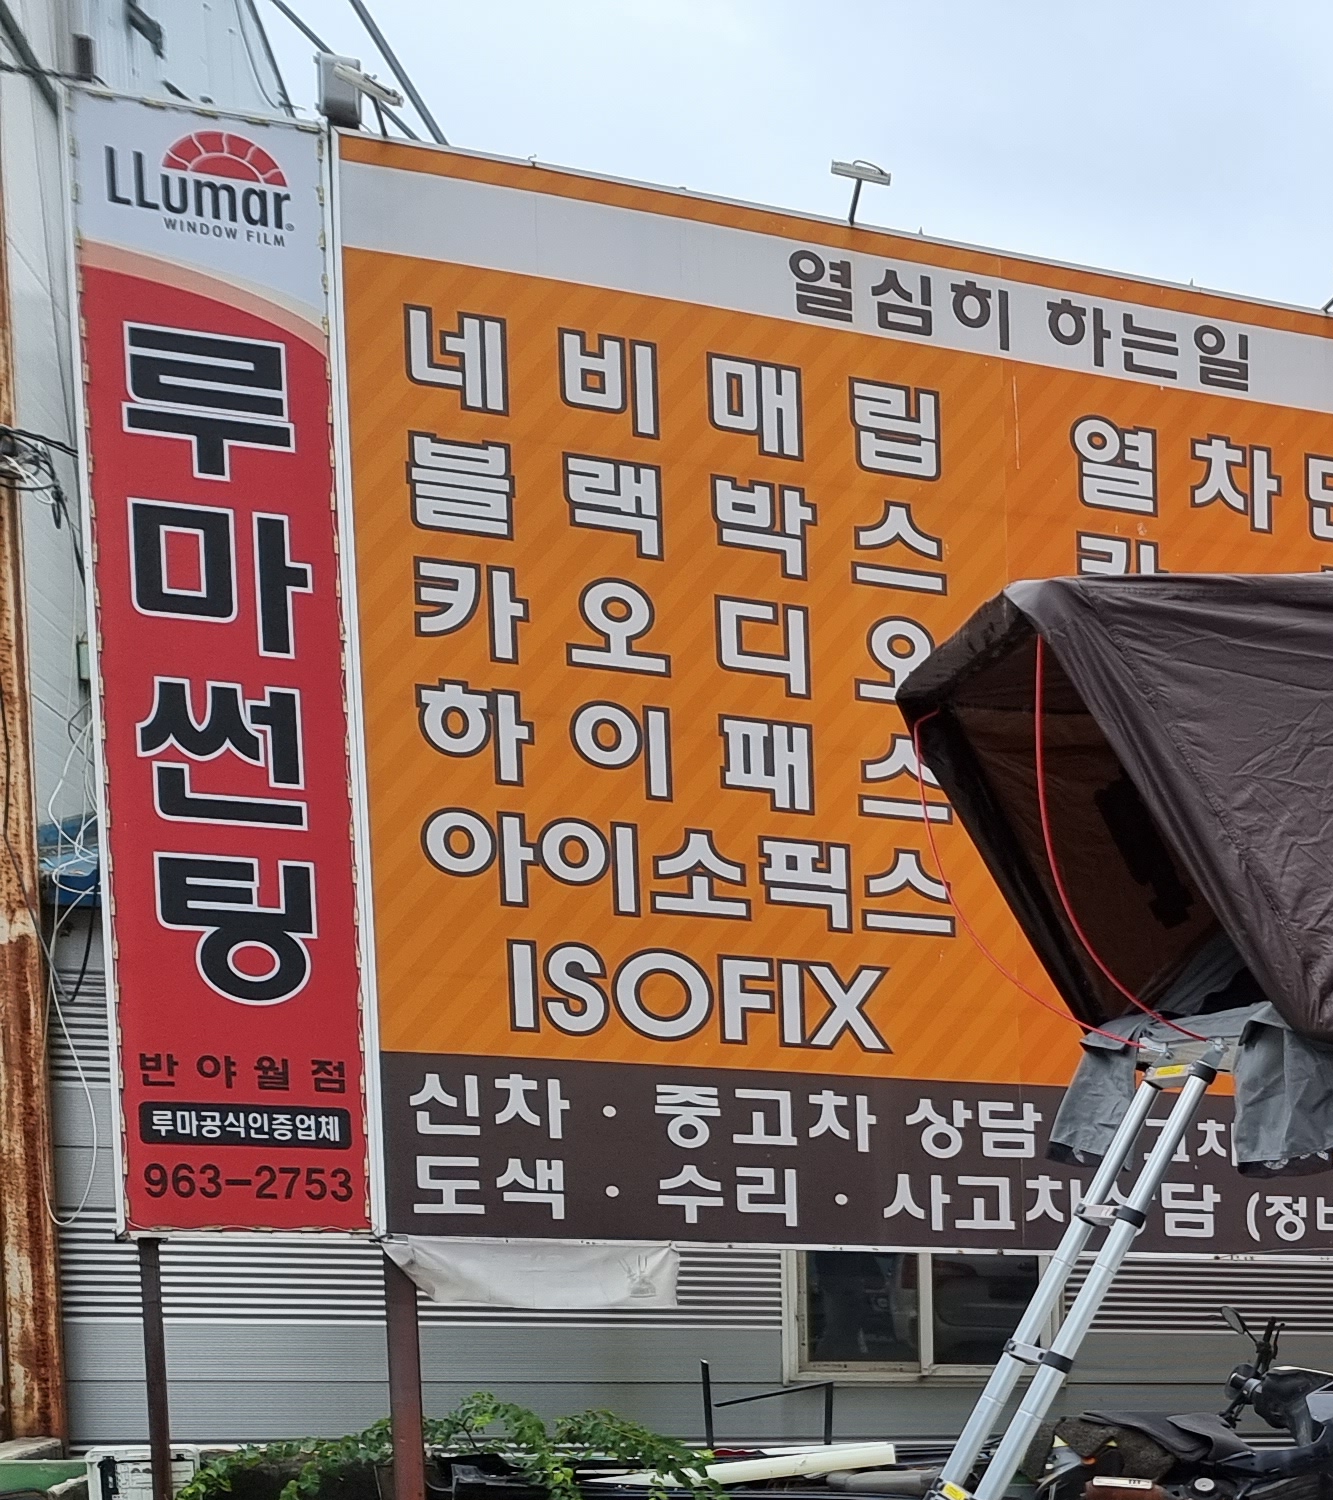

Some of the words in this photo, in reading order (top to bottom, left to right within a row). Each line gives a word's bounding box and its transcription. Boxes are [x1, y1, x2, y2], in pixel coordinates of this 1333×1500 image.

[104, 144, 292, 232] LLumar
[163, 216, 238, 242] WINDOW
[244, 227, 287, 248] FILM
[787, 247, 1011, 351] 열심히
[1046, 294, 1251, 393] 하는일
[403, 301, 942, 482] 네비매립
[406, 430, 947, 597] 블랙박스
[121, 320, 317, 1004] 루마썬팅
[415, 678, 953, 825] 하이패스
[421, 806, 957, 938] 아이소픽스
[506, 938, 893, 1056] ISOFIX
[138, 1053, 346, 1094] 반야월점
[408, 1071, 570, 1141] 신차
[654, 1083, 877, 1154] 중고차
[904, 1096, 1043, 1160] 상담
[151, 1109, 340, 1142] 루마공식인증업체
[143, 1162, 354, 1202] 963-2753
[413, 1151, 566, 1220] 도색
[655, 1163, 799, 1228] 수리
